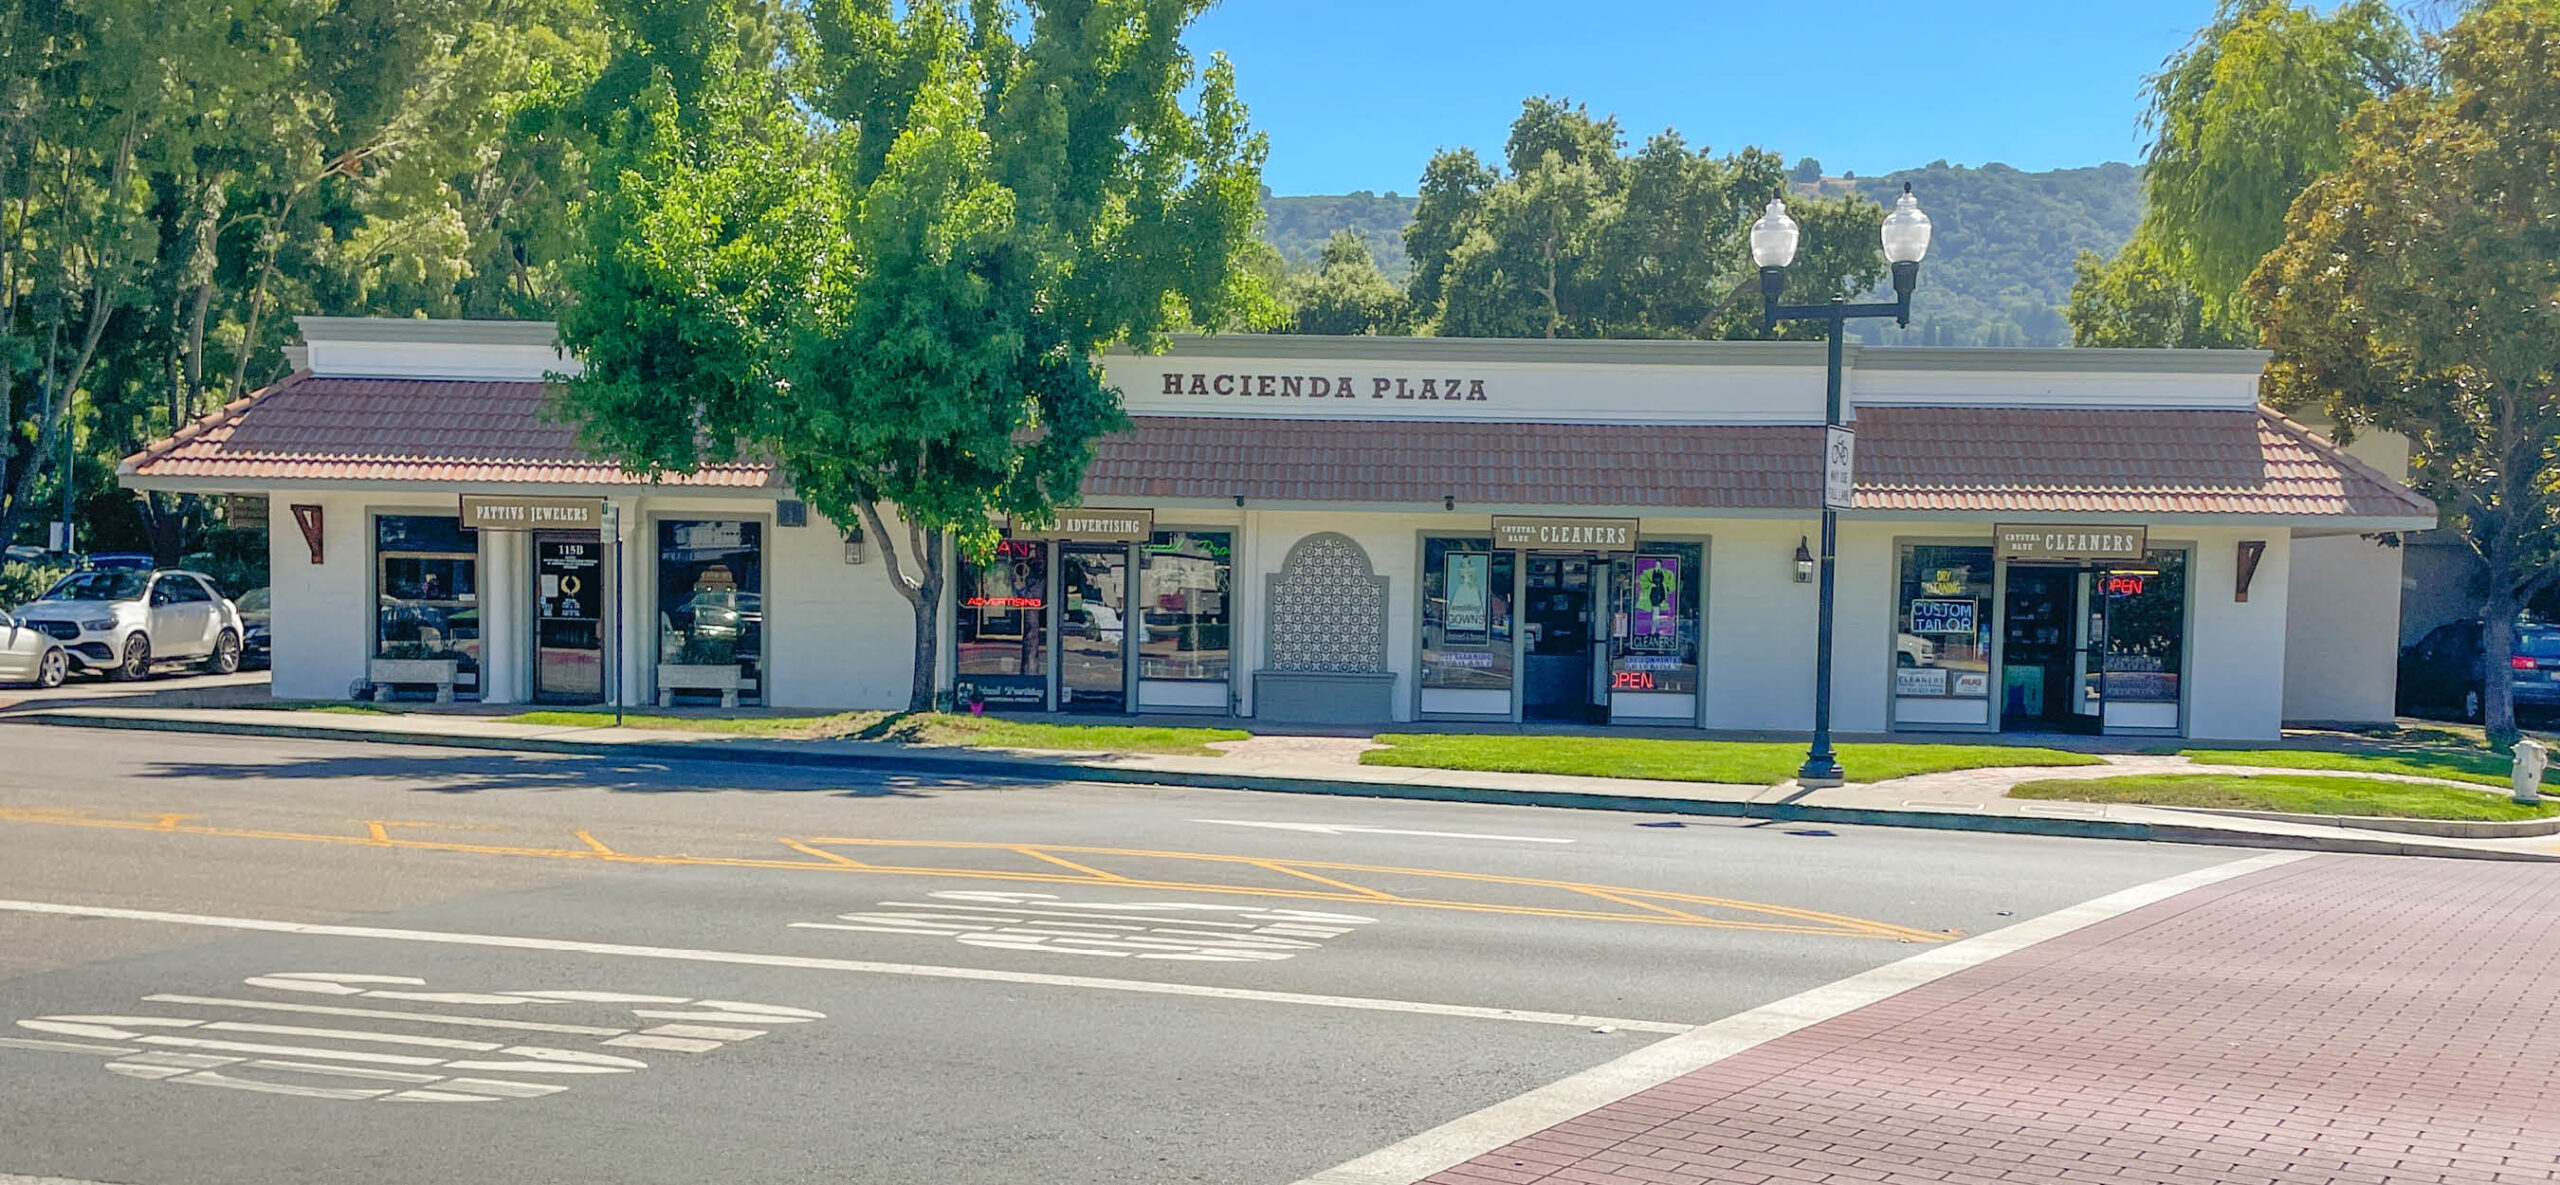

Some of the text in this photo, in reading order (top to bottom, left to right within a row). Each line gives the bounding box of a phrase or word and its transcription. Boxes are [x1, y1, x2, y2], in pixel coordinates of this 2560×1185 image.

[1162, 373, 1488, 400] HACIENDA PLAZA
[531, 506, 588, 522] JEWELERS
[1066, 519, 1140, 533] ADVERTISING
[1501, 525, 1537, 534] CRYSTAL
[1540, 526, 1626, 544] CLEANERS
[558, 544, 584, 555] 115B
[2011, 543, 2033, 551] BLUE
[2045, 534, 2133, 551] CLEANERS
[1936, 570, 1952, 582] DRY
[967, 597, 1042, 607] ADVERTISING
[1913, 602, 1973, 618] CUSTOM
[1447, 614, 1485, 625] GOWNS
[1633, 636, 1675, 648] CLEANERS
[788, 889, 1380, 961] STOP
[0, 972, 827, 1102] STOP
